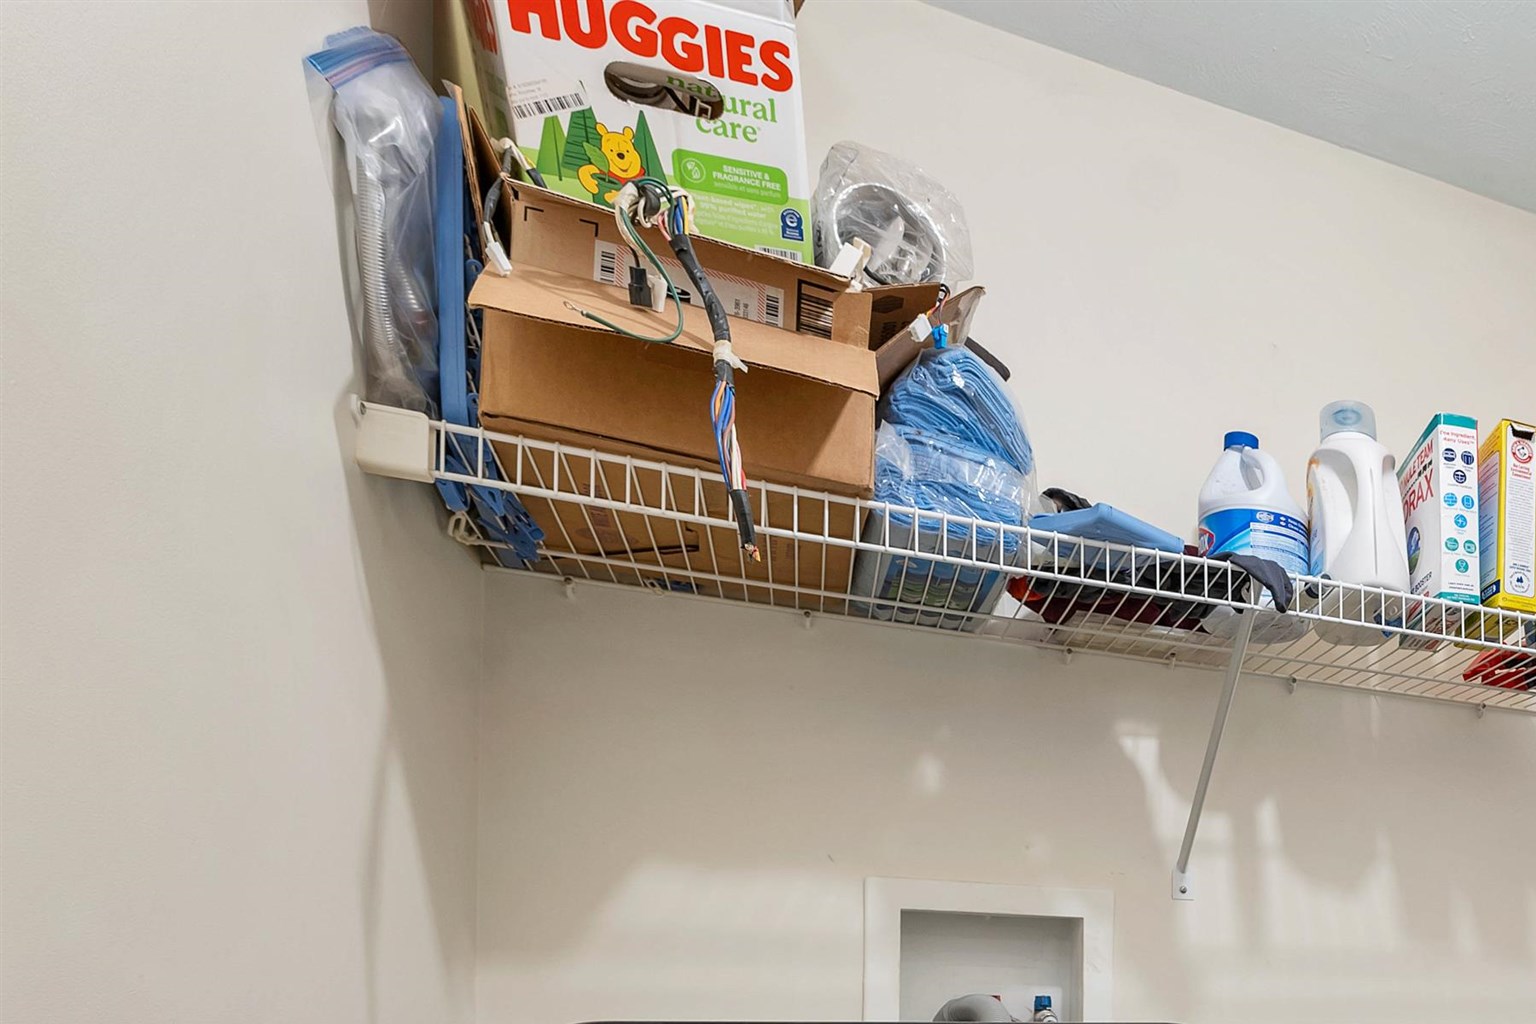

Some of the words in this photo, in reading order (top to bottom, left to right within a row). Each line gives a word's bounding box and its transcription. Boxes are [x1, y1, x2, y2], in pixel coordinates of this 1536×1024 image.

[508, 0, 793, 92] HUGGIES
[712, 171, 761, 186] FRAGRANCE
[762, 180, 781, 191] FREE
[722, 165, 762, 179] SENSITIVE
[1416, 438, 1434, 469] TEAM
[1402, 467, 1434, 525] ORAX
